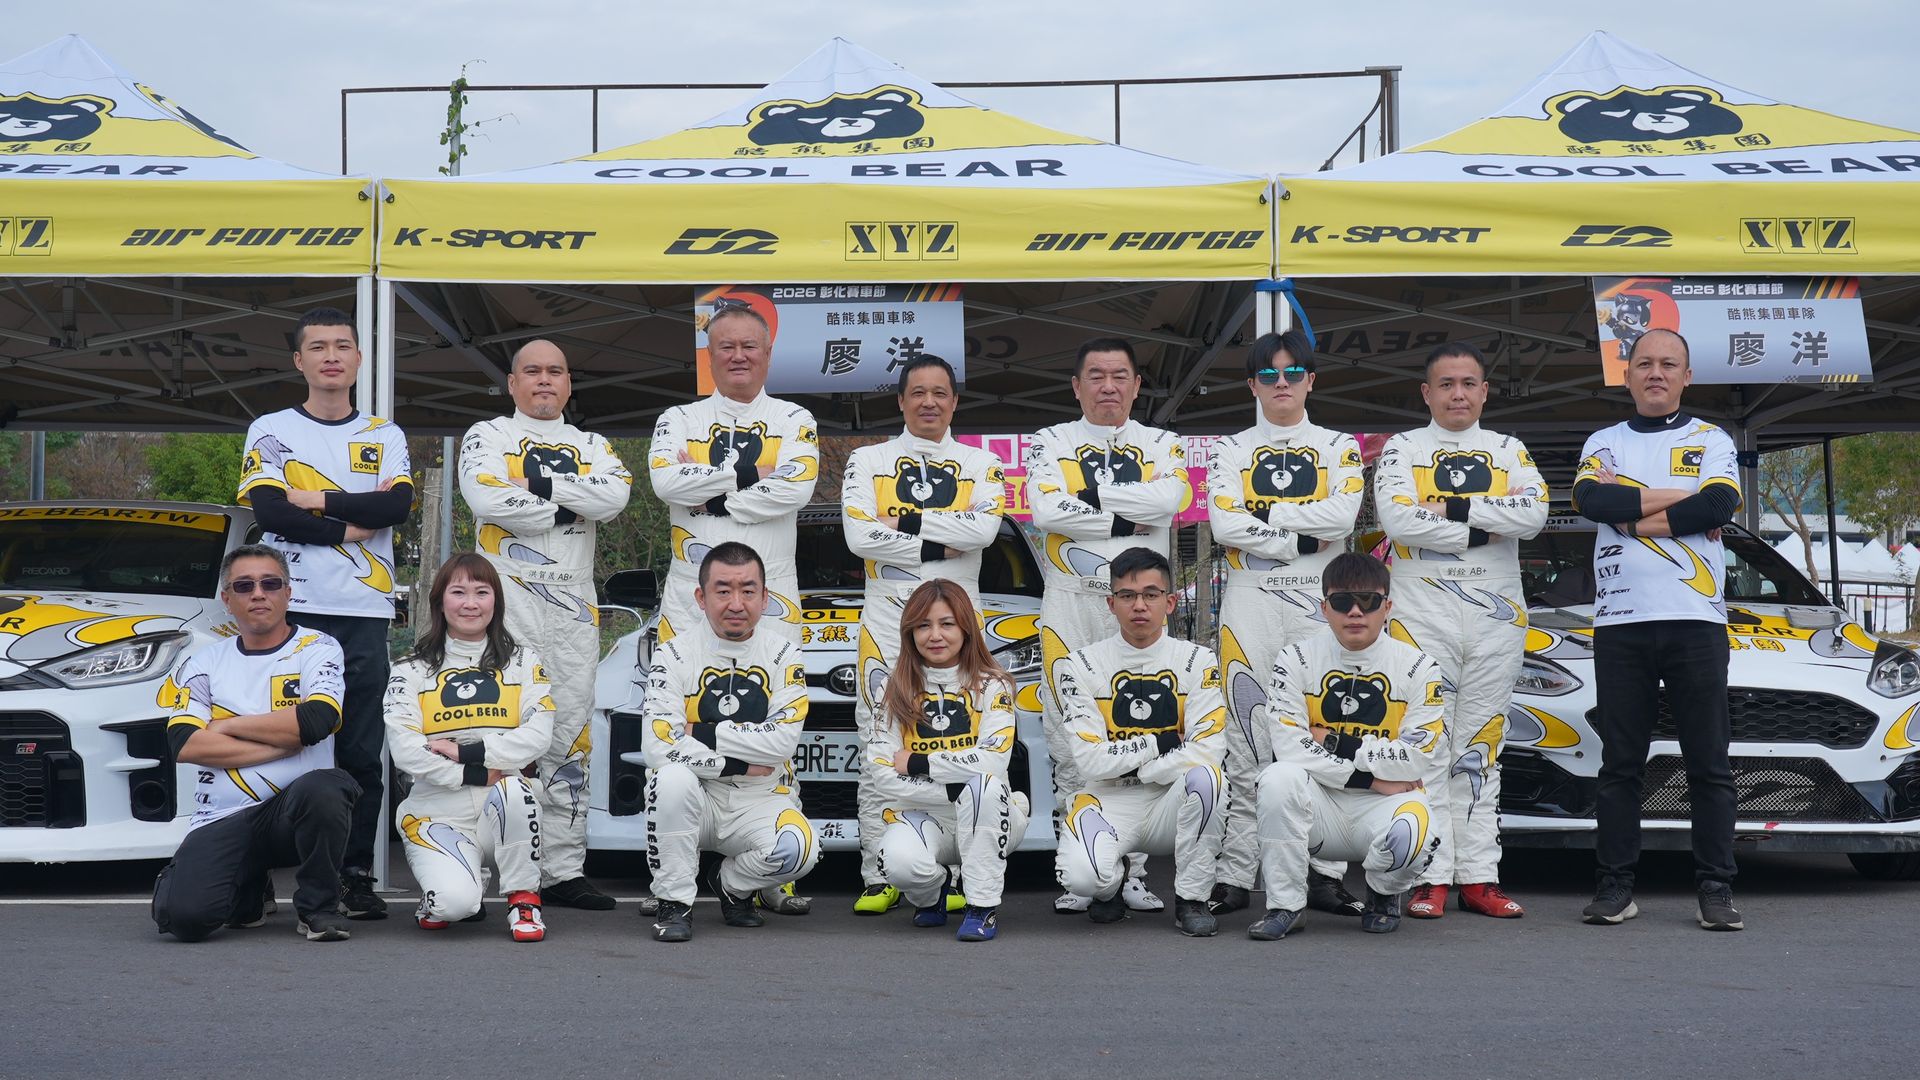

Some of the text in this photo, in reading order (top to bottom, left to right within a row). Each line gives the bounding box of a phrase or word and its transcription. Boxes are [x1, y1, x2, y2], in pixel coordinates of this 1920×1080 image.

[734, 136, 934, 156] 酷熊集團
[1566, 132, 1771, 156] 酷熊集團
[594, 159, 1067, 178] COOL BEAR
[1461, 153, 1920, 178] COOL BEAR
[394, 227, 596, 250] K-SPORT
[664, 228, 779, 255] D2
[847, 222, 958, 256] XYZ
[1290, 226, 1491, 244] K-SPORT
[1561, 225, 1673, 248] D2
[1742, 219, 1857, 252] XYZ
[772, 285, 886, 298] 2026 彰化賽車節
[1671, 283, 1783, 296] 2026 彰化賽車節
[826, 311, 915, 326] 酷熊集團車隊
[1727, 307, 1816, 321] 酷熊集團車隊
[353, 462, 373, 471] COOL
[22, 567, 70, 576] RECARO
[1598, 564, 1620, 579] XYZ
[1266, 575, 1320, 586] PETER LIAO
[802, 610, 846, 620] OL
[1728, 624, 1798, 638] EAR
[433, 707, 508, 723] COOL BEAR
[911, 740, 947, 752] COOL
